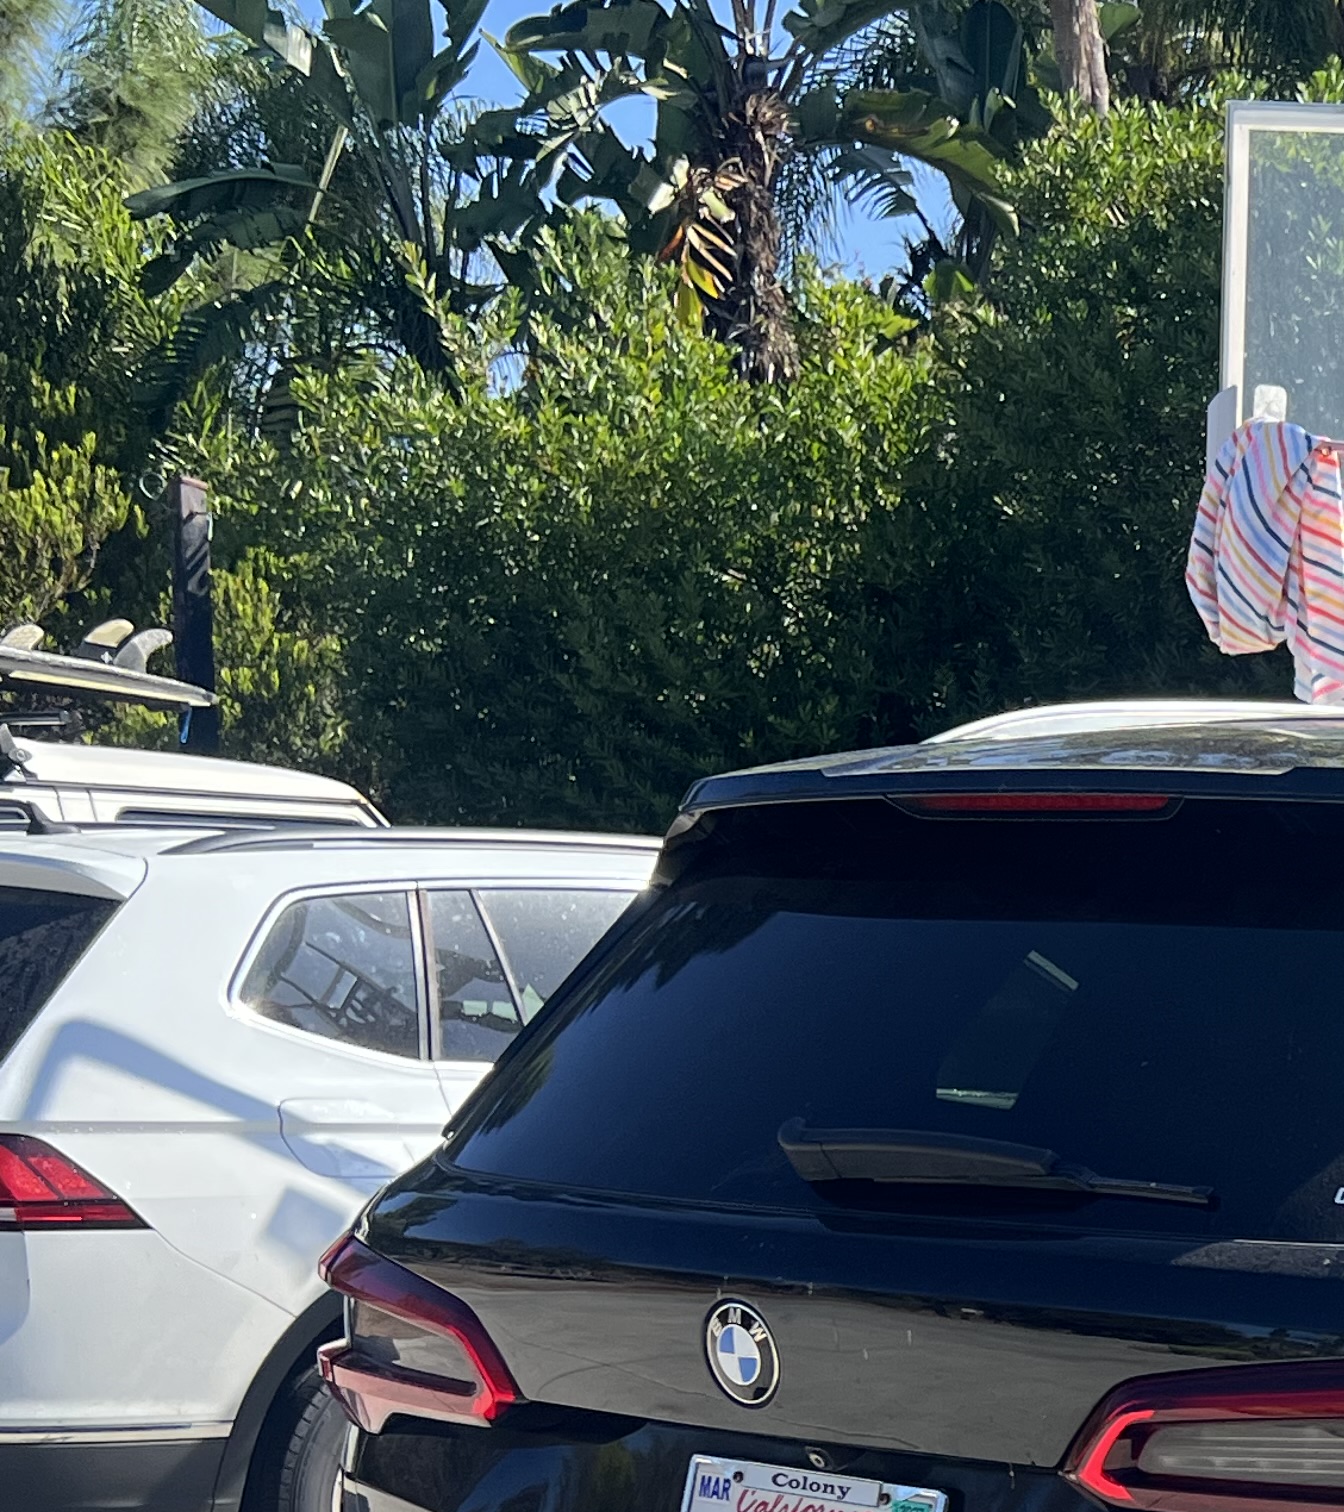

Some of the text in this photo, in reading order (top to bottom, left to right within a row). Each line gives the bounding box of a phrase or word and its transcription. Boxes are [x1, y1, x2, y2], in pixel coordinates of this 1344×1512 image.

[711, 1307, 768, 1342] BMW
[699, 1475, 731, 1500] MAR
[771, 1472, 852, 1500] Colony
